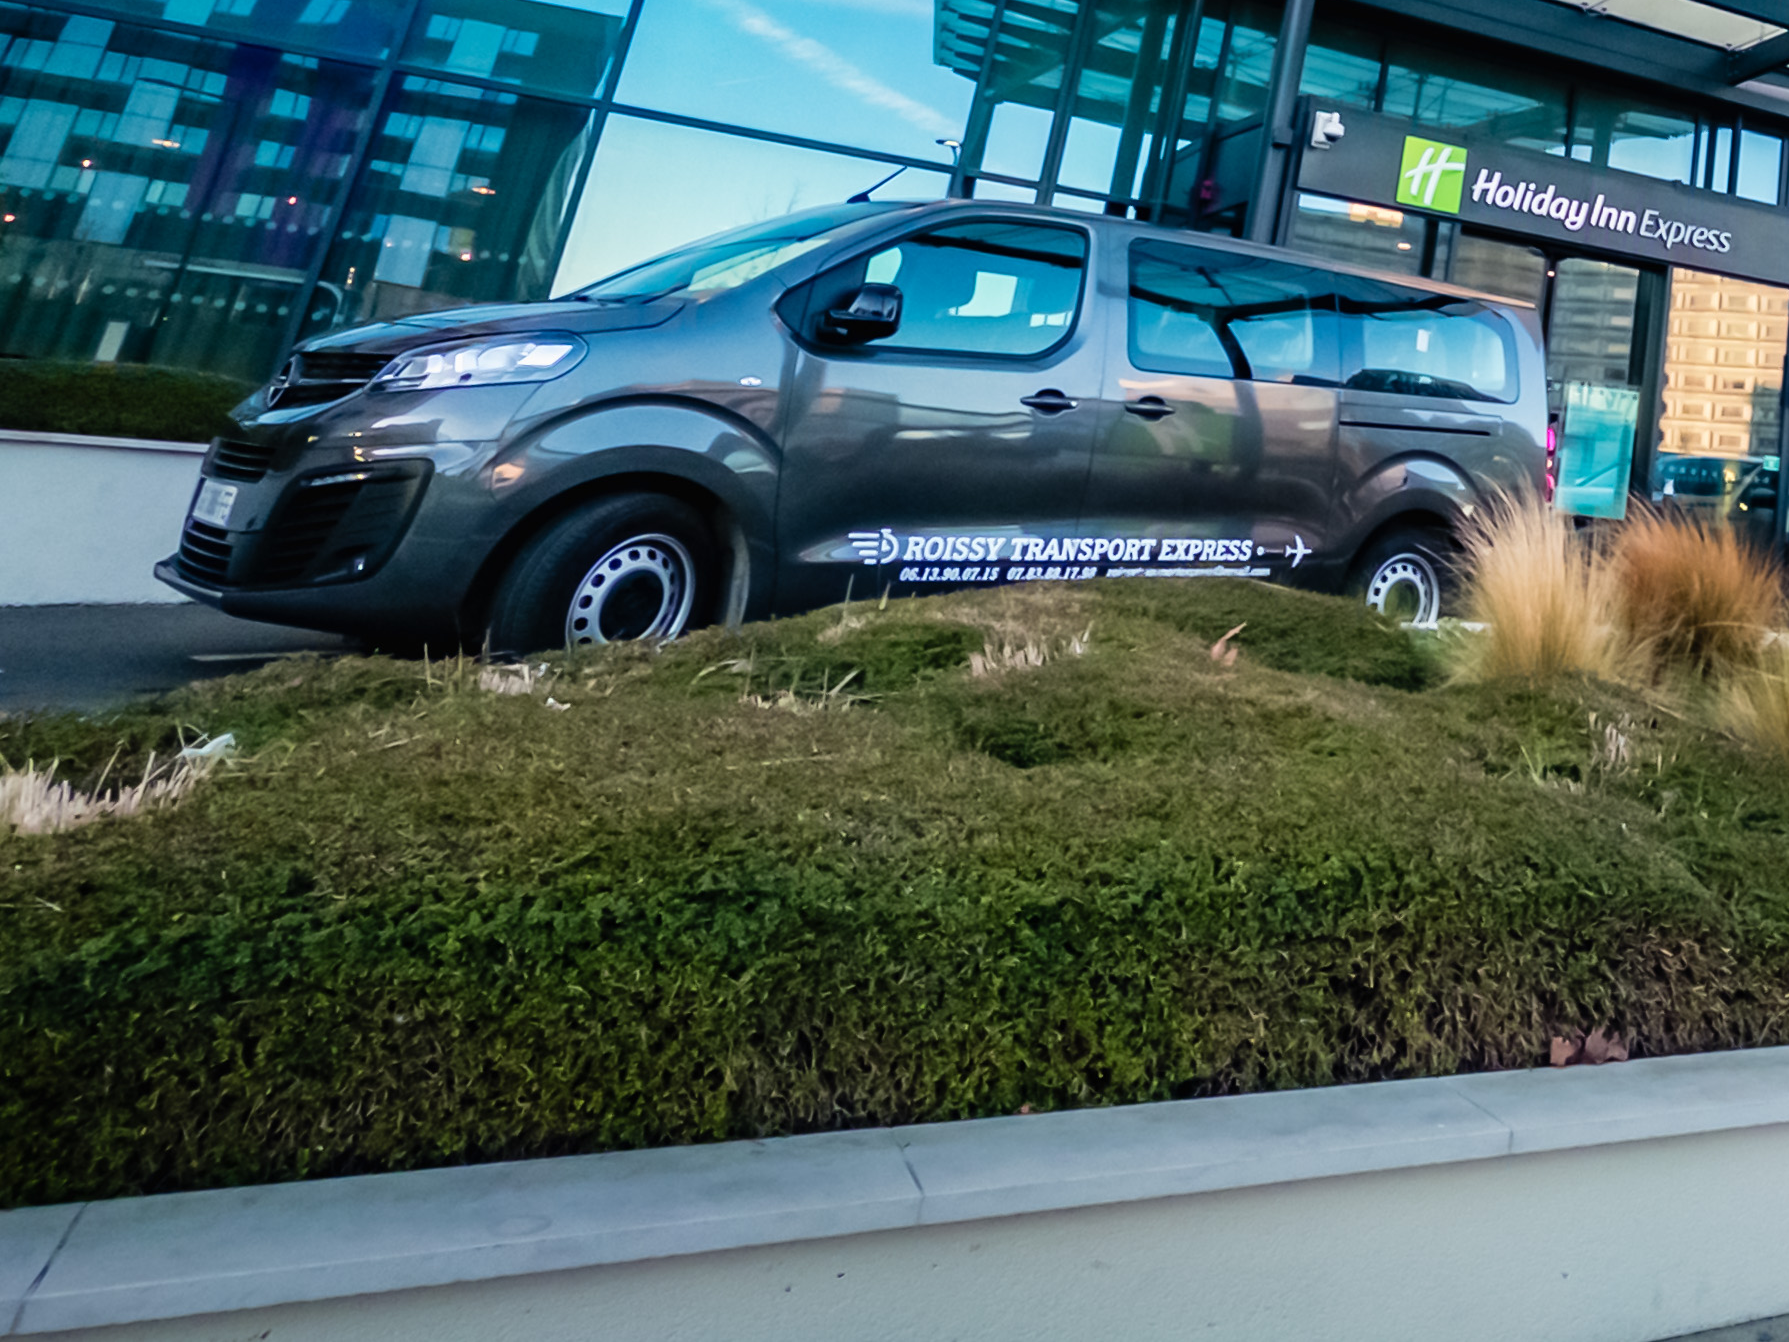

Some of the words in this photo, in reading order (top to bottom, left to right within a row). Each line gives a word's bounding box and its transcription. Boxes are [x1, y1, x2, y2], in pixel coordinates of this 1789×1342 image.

[1472, 168, 1588, 231] Holiday
[1590, 194, 1636, 234] Inn
[1639, 209, 1732, 253] Express
[903, 536, 1007, 562] ROISSY
[1009, 537, 1157, 562] TRANSPORT
[1157, 539, 1253, 562] EXPRESS
